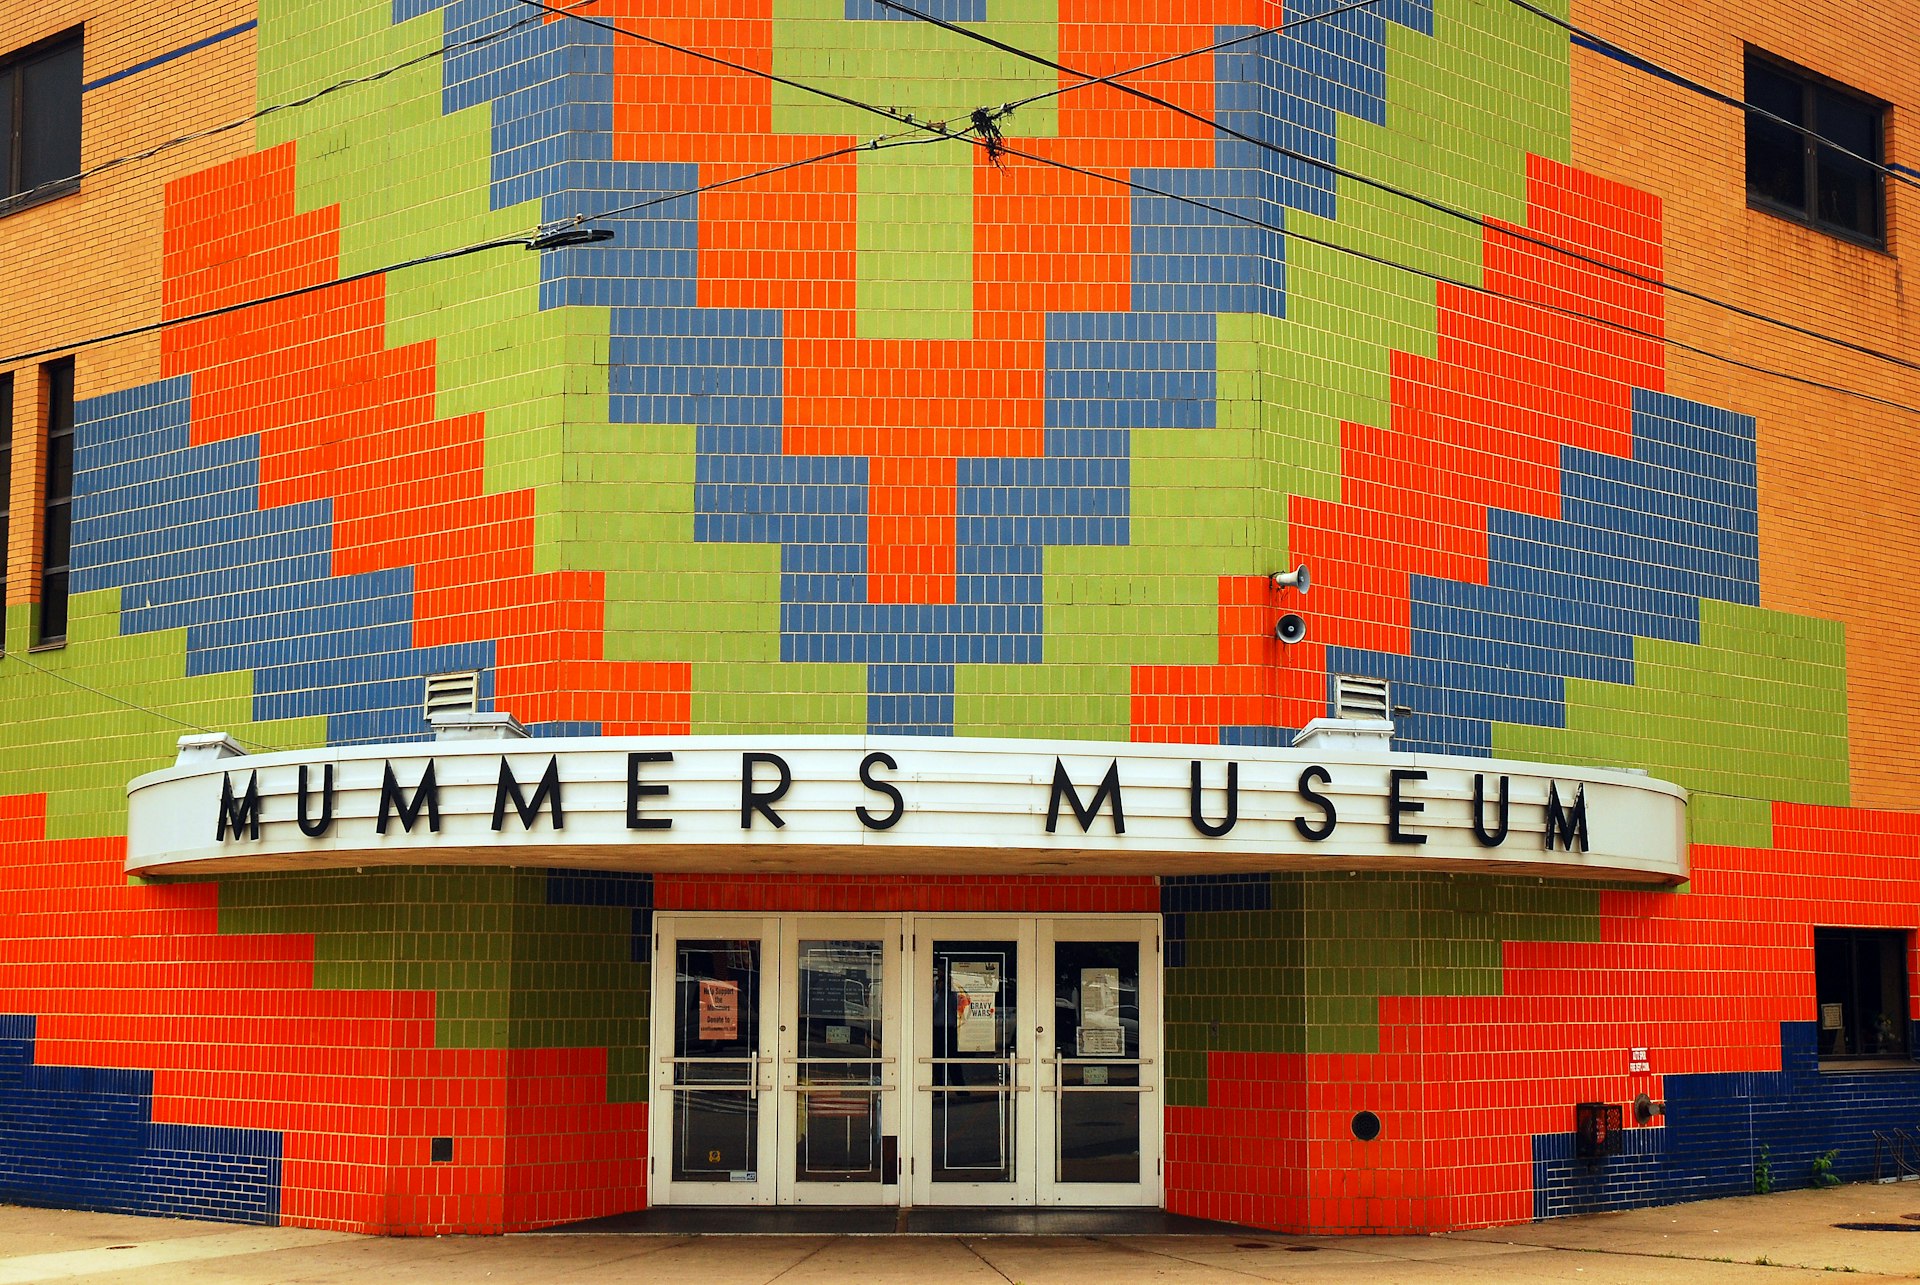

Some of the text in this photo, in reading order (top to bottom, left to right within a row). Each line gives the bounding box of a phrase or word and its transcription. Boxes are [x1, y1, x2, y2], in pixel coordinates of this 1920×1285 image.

[215, 750, 1590, 854] MUMMERS MUSEUM
[715, 988, 734, 996] Support
